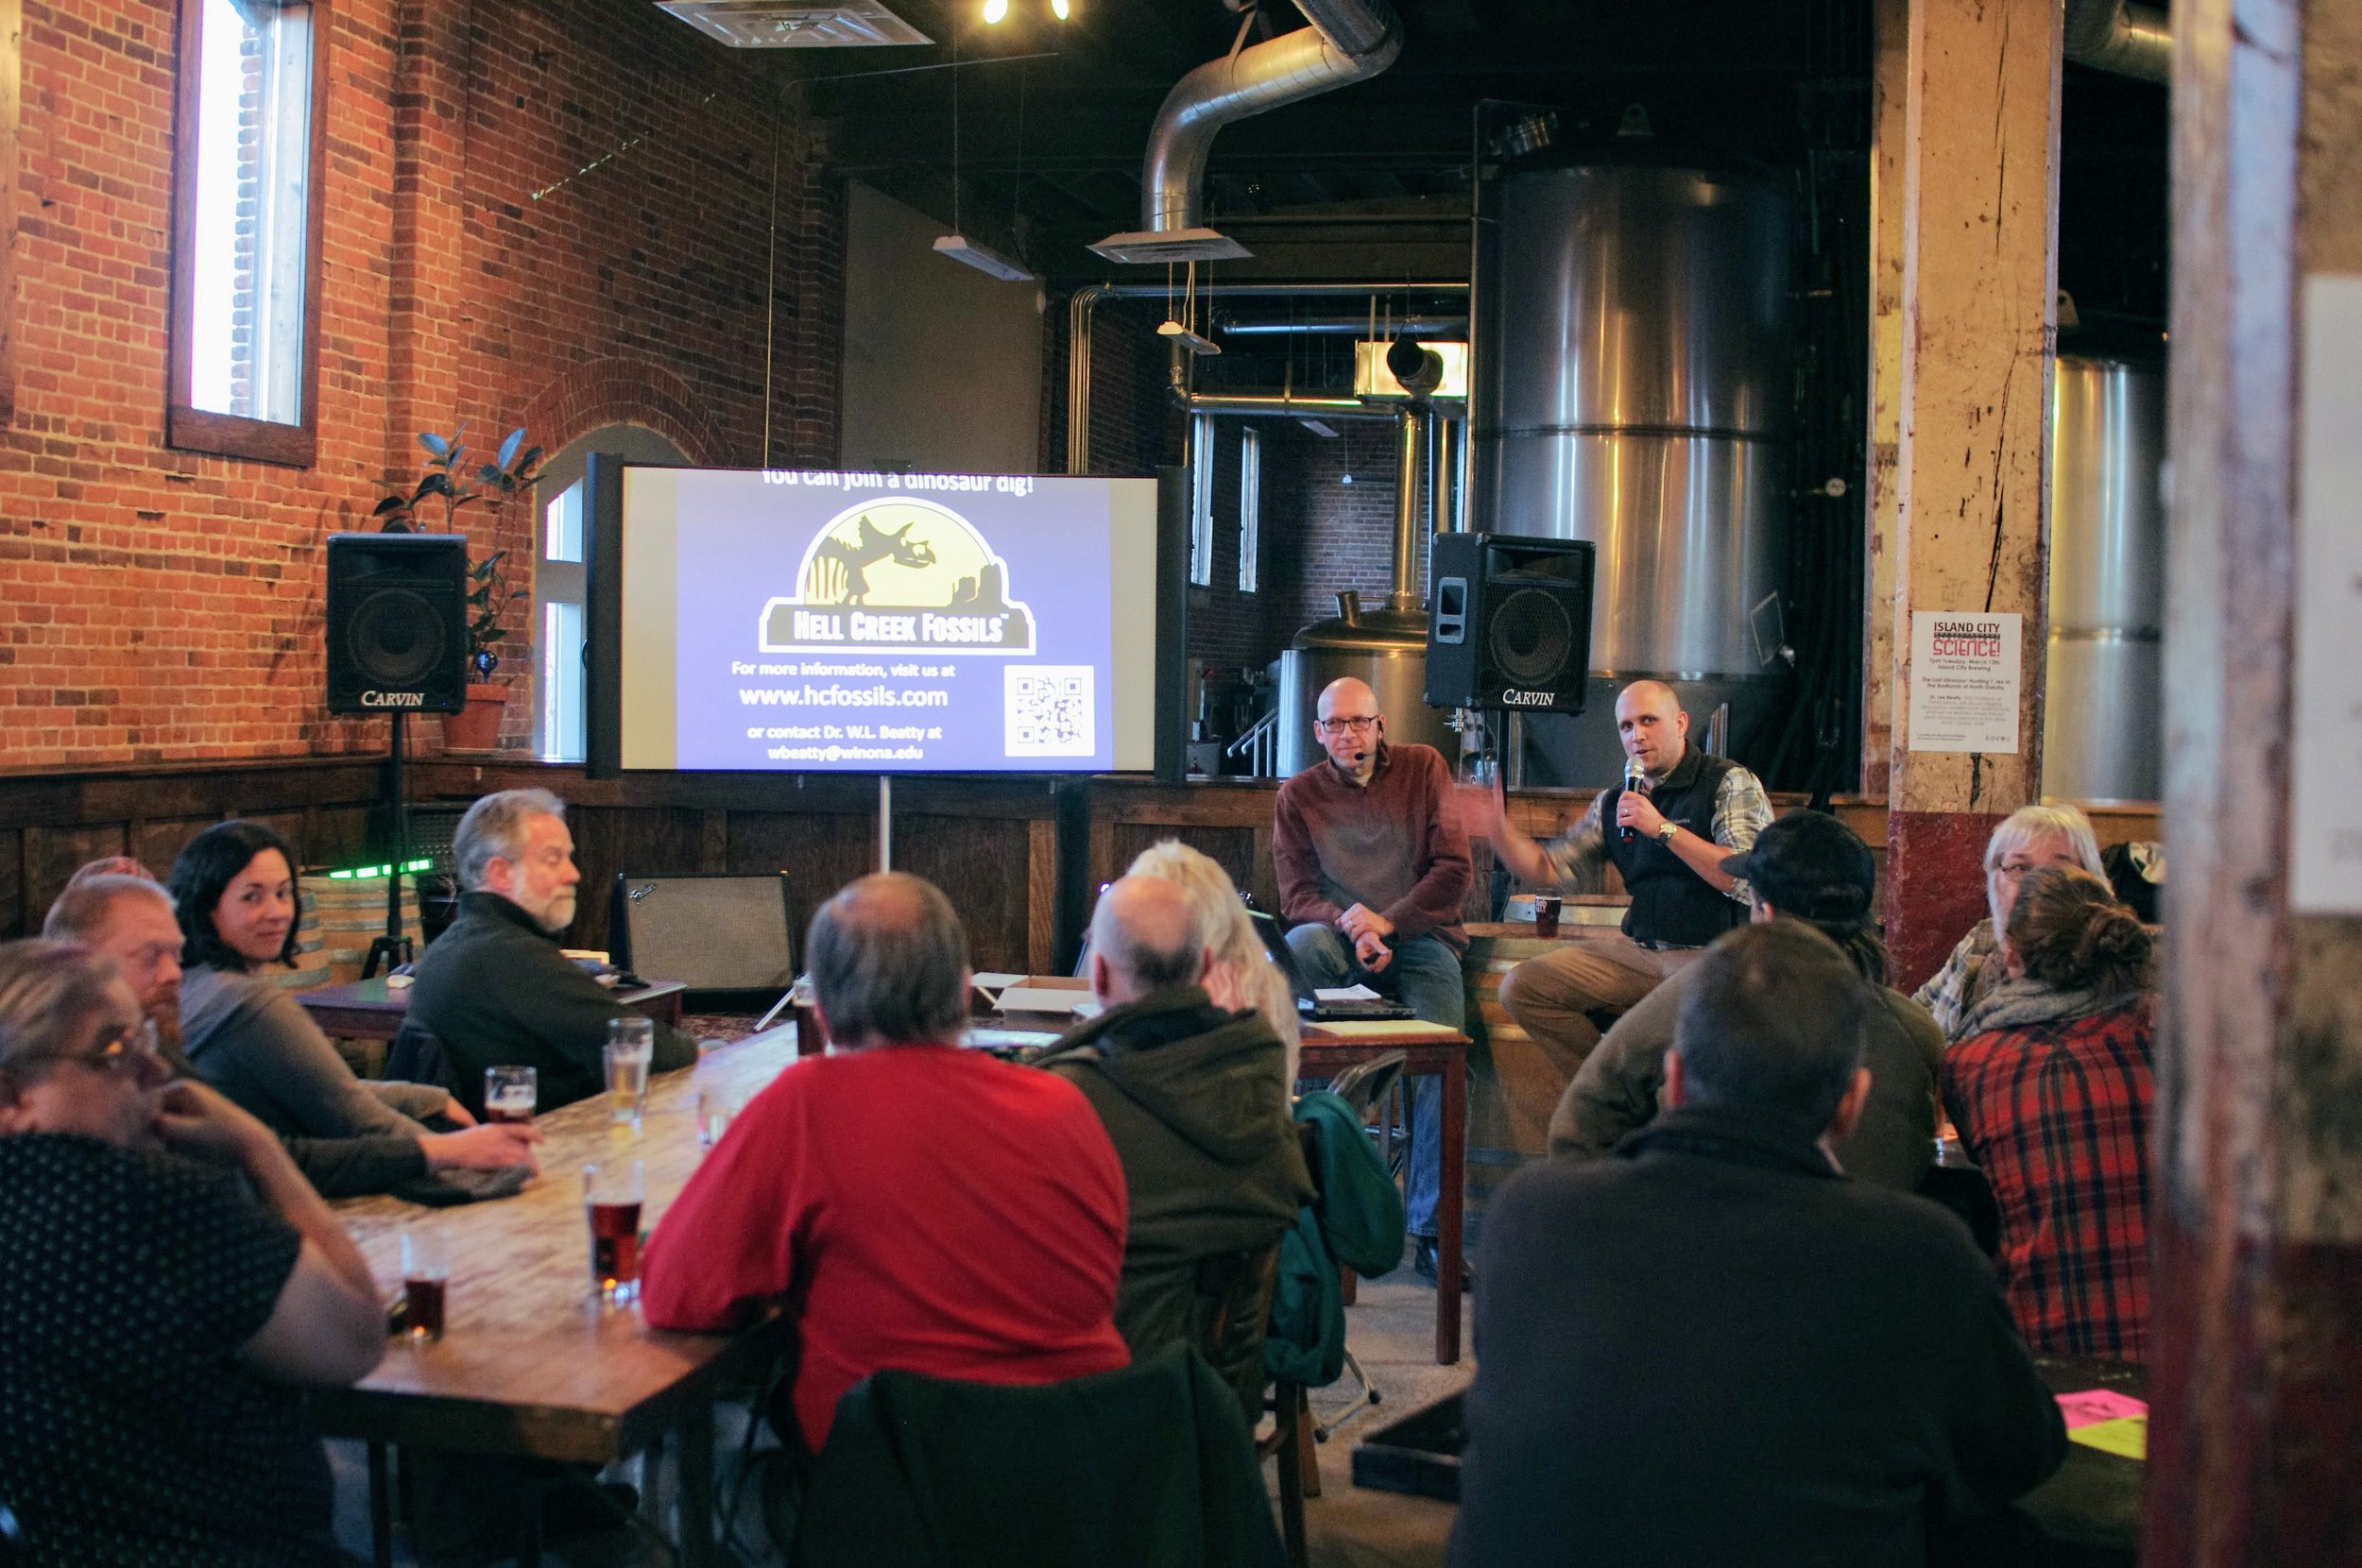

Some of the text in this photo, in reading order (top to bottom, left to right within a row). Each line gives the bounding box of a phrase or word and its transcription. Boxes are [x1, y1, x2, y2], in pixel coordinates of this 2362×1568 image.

[802, 471, 839, 486] can
[887, 473, 900, 488] a
[904, 474, 991, 491] dinosaur
[996, 475, 1034, 497] dig!
[794, 611, 845, 640] HELL
[850, 611, 916, 641] CREEK
[1934, 622, 2000, 633] ISLAND CITY
[1932, 639, 2000, 657] SCIENCE!
[731, 661, 957, 678] For more information, visit us at
[361, 690, 424, 706] CARVIN
[739, 684, 950, 707] www.hcfossils.com
[1502, 689, 1555, 706] CARVIN
[746, 724, 944, 741] or contact Dr. W.L. Beatty at
[767, 745, 925, 761] wbeatty@winona.edu
